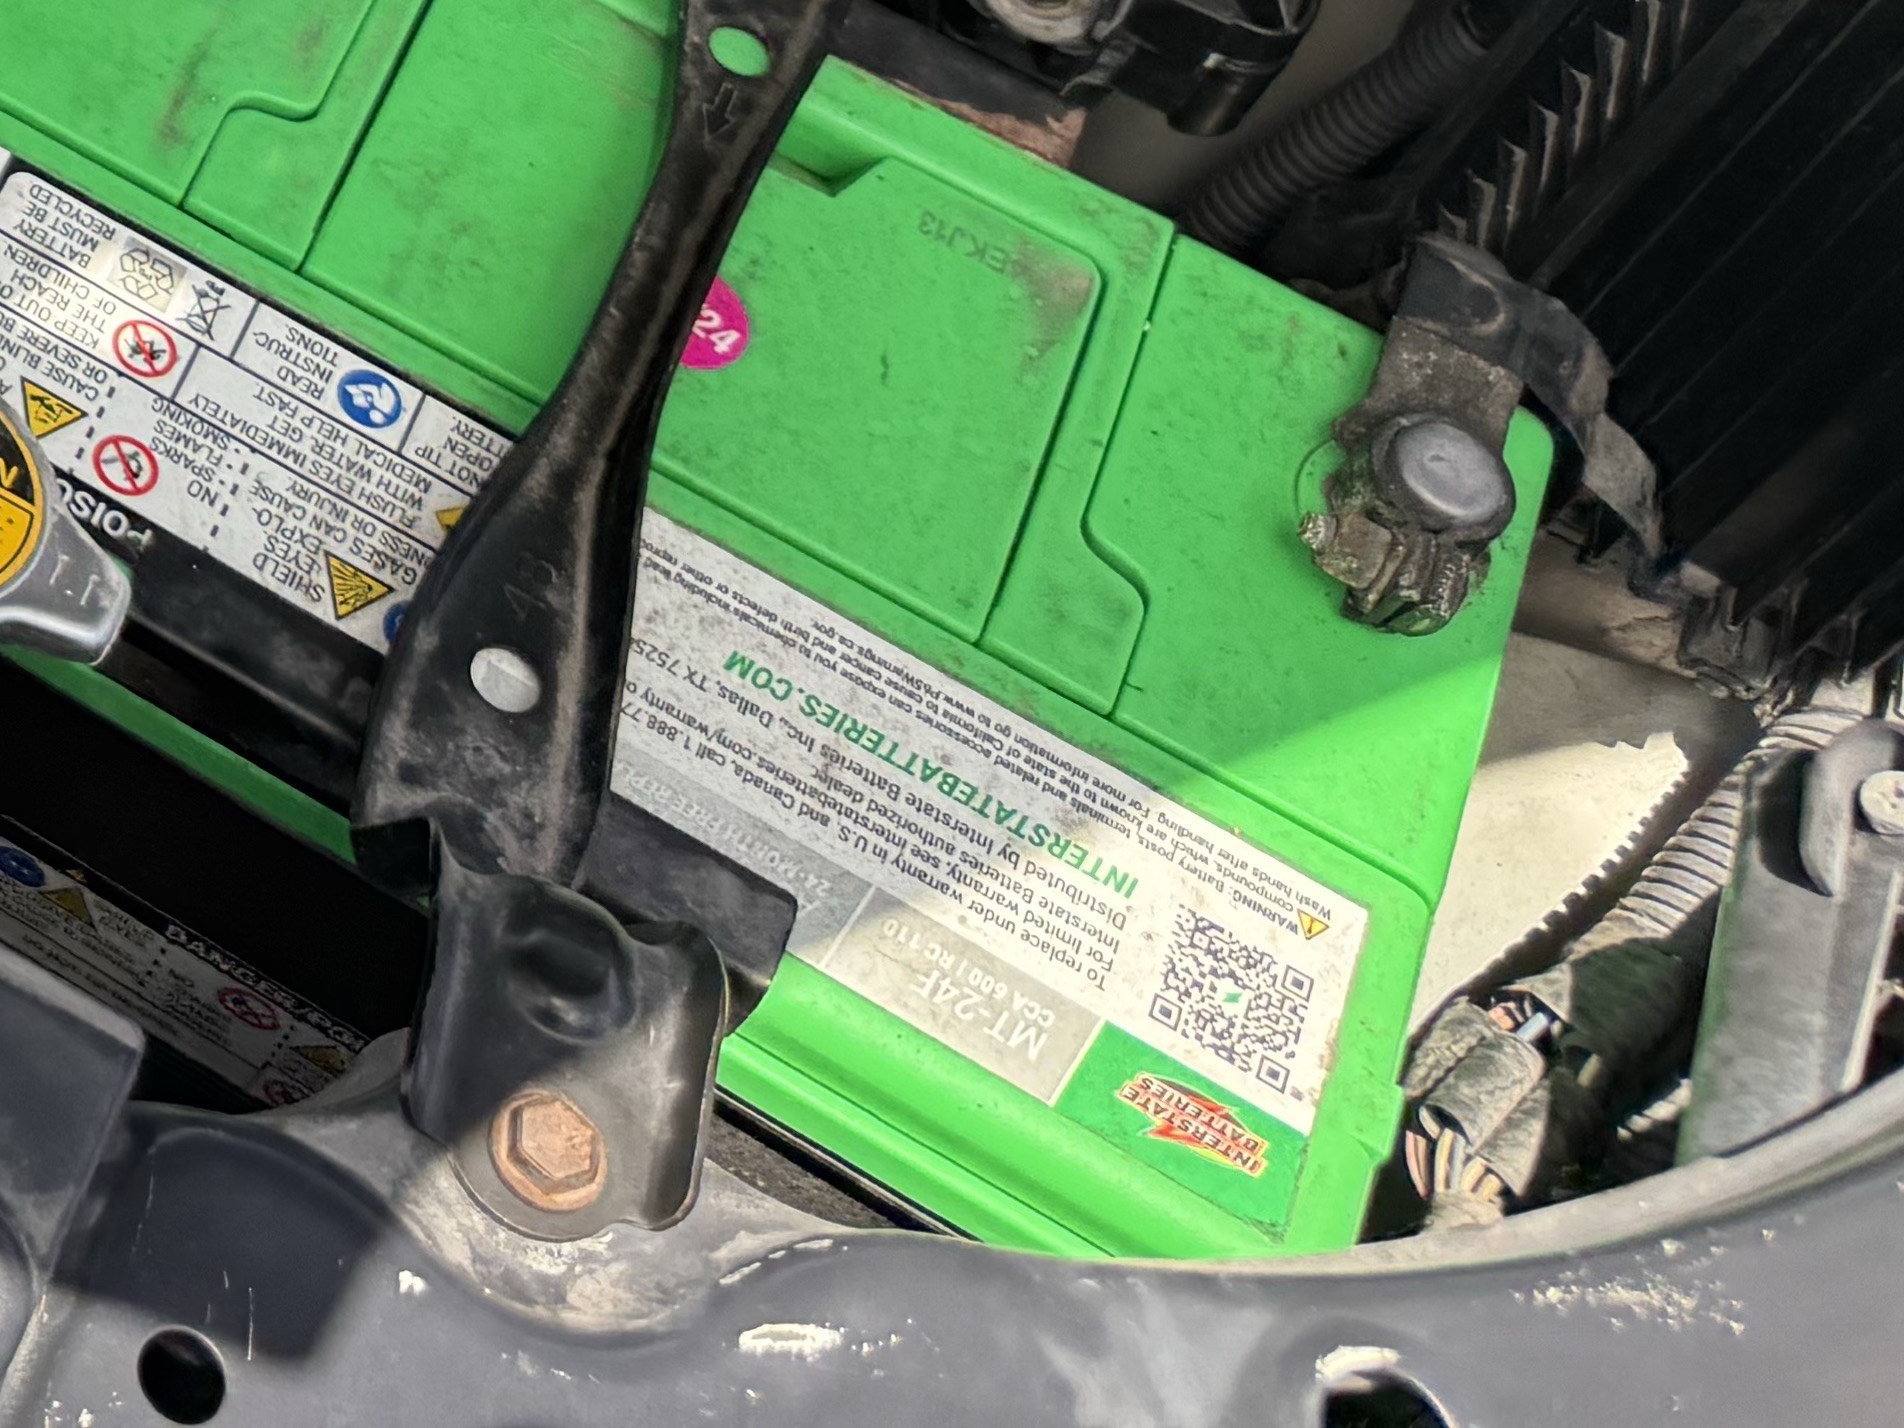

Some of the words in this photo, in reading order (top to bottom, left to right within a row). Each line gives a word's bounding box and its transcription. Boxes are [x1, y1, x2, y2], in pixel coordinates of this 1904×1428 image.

[23, 202, 48, 223] BE
[13, 219, 91, 268] BATTERY
[48, 218, 99, 252] MUST
[10, 268, 70, 310] REACH
[93, 298, 116, 315] OF
[14, 294, 51, 321] OUT
[73, 304, 105, 332] THE
[54, 317, 99, 349] KEEP
[691, 304, 741, 355] 24
[17, 328, 82, 369] SEVERE
[253, 332, 333, 383] INSTRUC-
[42, 361, 99, 401] CAUSE
[82, 362, 108, 384] OR
[277, 366, 324, 400] READ
[152, 397, 233, 450] SMOKING
[189, 394, 306, 468] IMMEDIATELY
[267, 416, 303, 443] GET
[300, 416, 348, 447] HELP
[451, 417, 508, 460] TTERY.
[150, 437, 216, 482] SPARKS
[154, 420, 223, 466] FLAMES
[415, 444, 441, 468] TIP
[443, 437, 493, 472] OPEN
[309, 460, 356, 495] EYES
[356, 440, 432, 494] MEDICAL
[188, 480, 218, 507] NO
[249, 479, 306, 521] CAUSE
[358, 487, 418, 529] FLUSH
[376, 476, 423, 512] WITH
[252, 505, 326, 554] EXPLO-
[309, 514, 347, 543] CAN
[351, 514, 376, 537] OR
[253, 553, 325, 602] SHIELD
[350, 537, 418, 586] GASES
[683, 666, 706, 692] TX
[814, 653, 838, 672] you
[889, 695, 912, 713] can
[618, 702, 690, 750] 1.888.77
[696, 742, 726, 766] call
[1006, 746, 1021, 758] of
[1024, 755, 1056, 779] state
[723, 651, 1132, 895] INTERSTATEBATTERIES.COM
[728, 760, 795, 809] Canada,
[820, 744, 900, 801] Batteries
[994, 755, 1040, 786] related
[1060, 776, 1080, 794] the
[1042, 782, 1067, 801] and
[1128, 799, 1150, 818] For
[671, 794, 722, 834] FREE
[798, 802, 830, 826] and
[866, 799, 956, 855] authorized
[906, 793, 993, 854] Interstate
[834, 822, 868, 852] U.S.
[872, 844, 888, 864] in
[911, 844, 941, 868] see
[998, 843, 1020, 870] by
[1178, 856, 1224, 892] Battery
[890, 853, 962, 903] warranty
[959, 851, 1033, 904] Batteries
[1024, 860, 1126, 930] Distributed
[879, 914, 925, 952] 110
[968, 900, 1015, 934] under
[1023, 910, 1082, 954] limited
[1039, 896, 1119, 954] Interstate
[924, 940, 956, 970] RC
[1021, 929, 1082, 972] replace
[1086, 947, 1113, 972] For
[965, 964, 1010, 1001] 600
[1087, 968, 1104, 991] To
[907, 962, 1049, 1062] MT-24F
[1007, 988, 1058, 1029] CCA
[1121, 1084, 1261, 1174] INTERSTATE
[1137, 1075, 1259, 1153] BATTERIES
